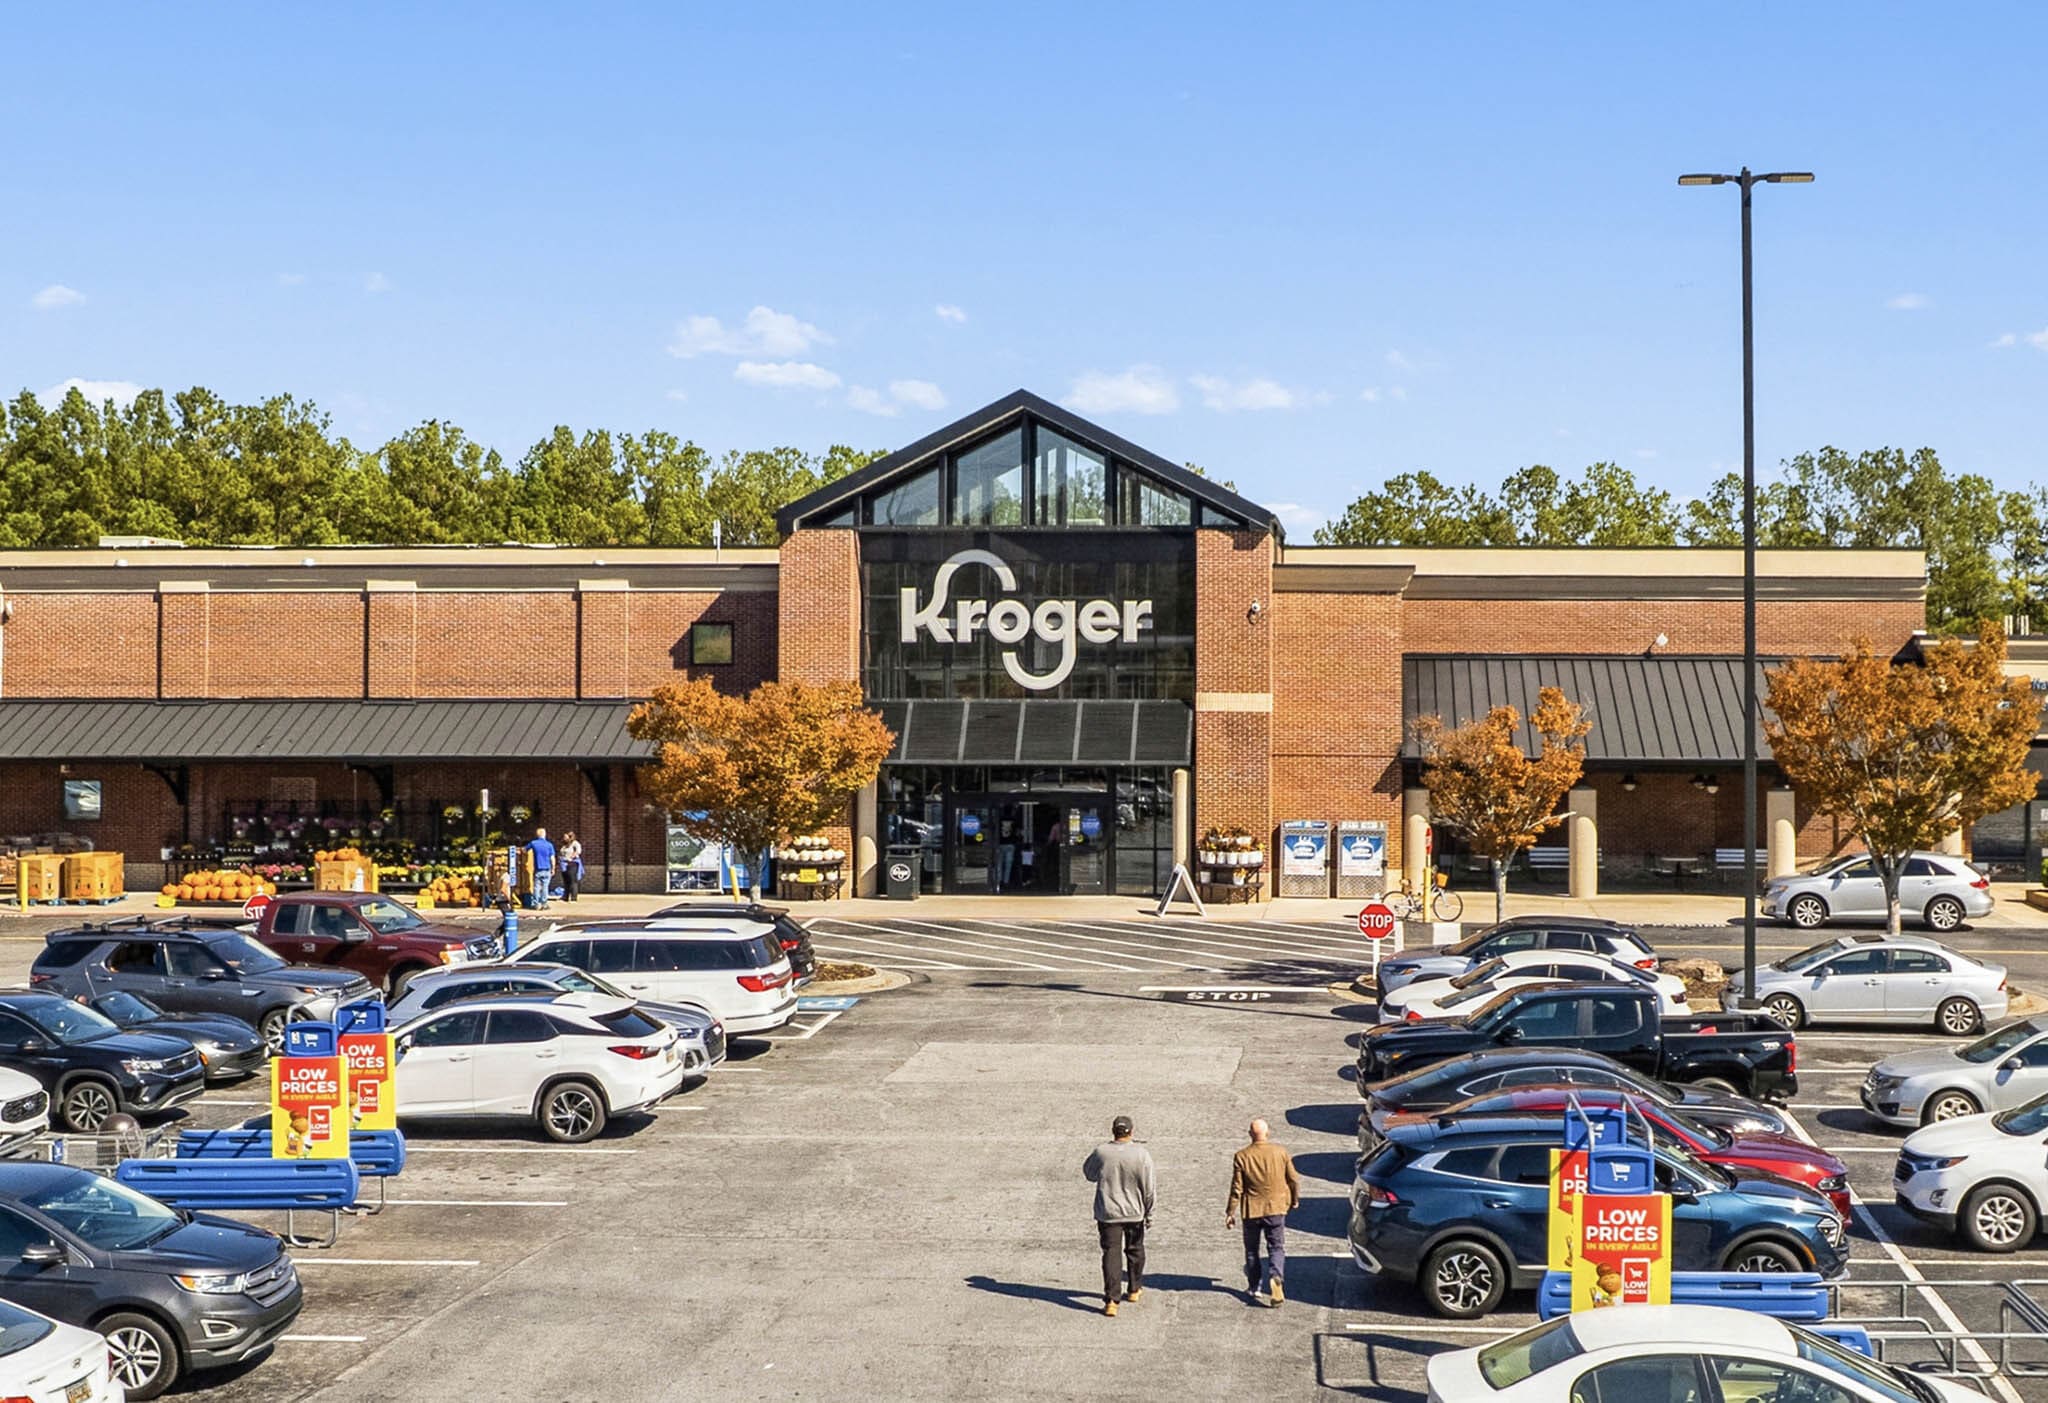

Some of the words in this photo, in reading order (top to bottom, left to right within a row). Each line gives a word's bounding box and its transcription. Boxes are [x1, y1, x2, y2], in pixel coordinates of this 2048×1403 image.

[901, 549, 1152, 690] Kroger
[1361, 913, 1392, 928] STOP
[1186, 991, 1272, 1001] STOP
[340, 1044, 375, 1056] LOW
[290, 1068, 328, 1080] LOW
[281, 1080, 337, 1093] PRICES
[1598, 1209, 1647, 1225] LOW
[1586, 1226, 1658, 1241] PRICES
[1599, 1242, 1630, 1251] EVERY
[1625, 1281, 1647, 1289] LOW
